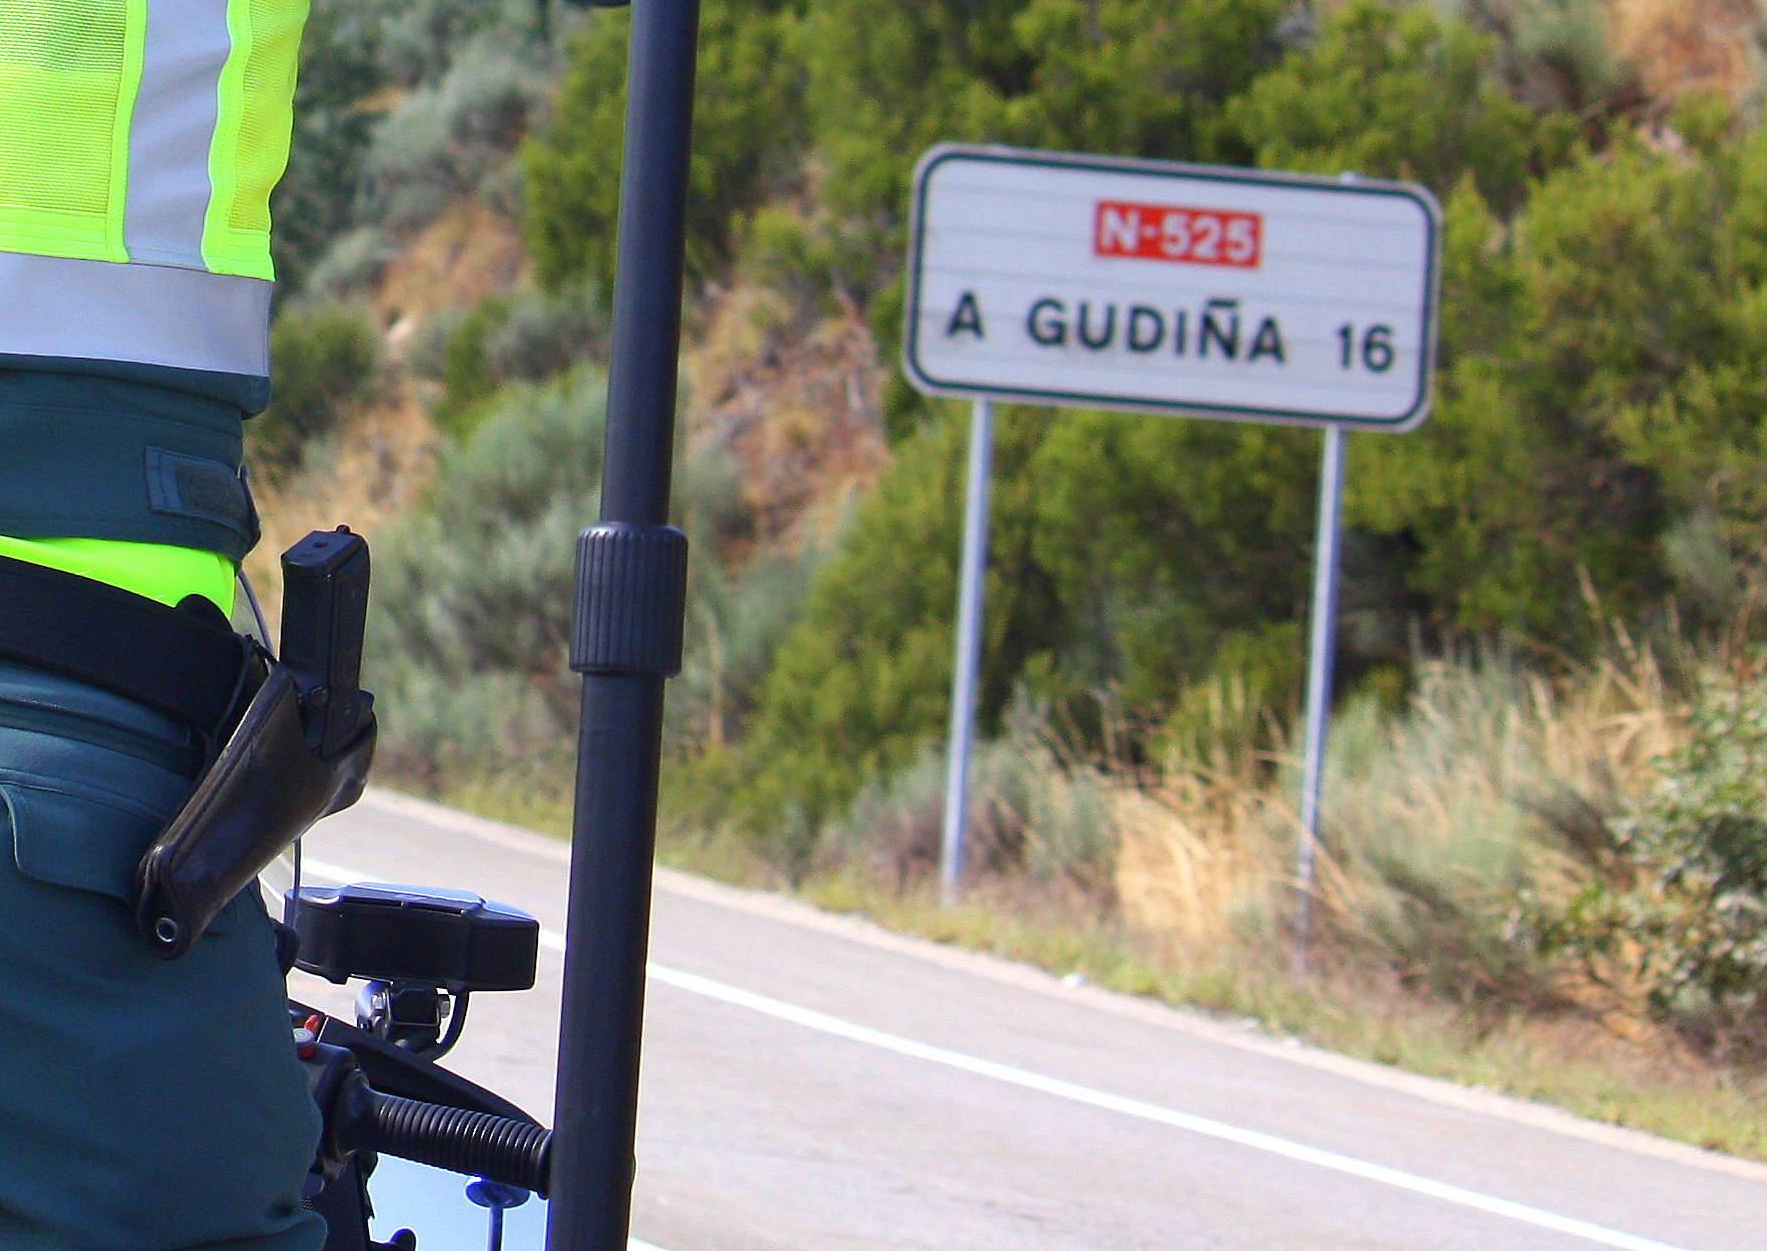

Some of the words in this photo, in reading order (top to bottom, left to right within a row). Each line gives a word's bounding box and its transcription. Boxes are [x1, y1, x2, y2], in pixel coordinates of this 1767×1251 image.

[1099, 208, 1257, 262] N-525
[945, 291, 985, 340] A
[1025, 297, 1287, 364] GUDIÑA
[1337, 323, 1395, 373] 16
